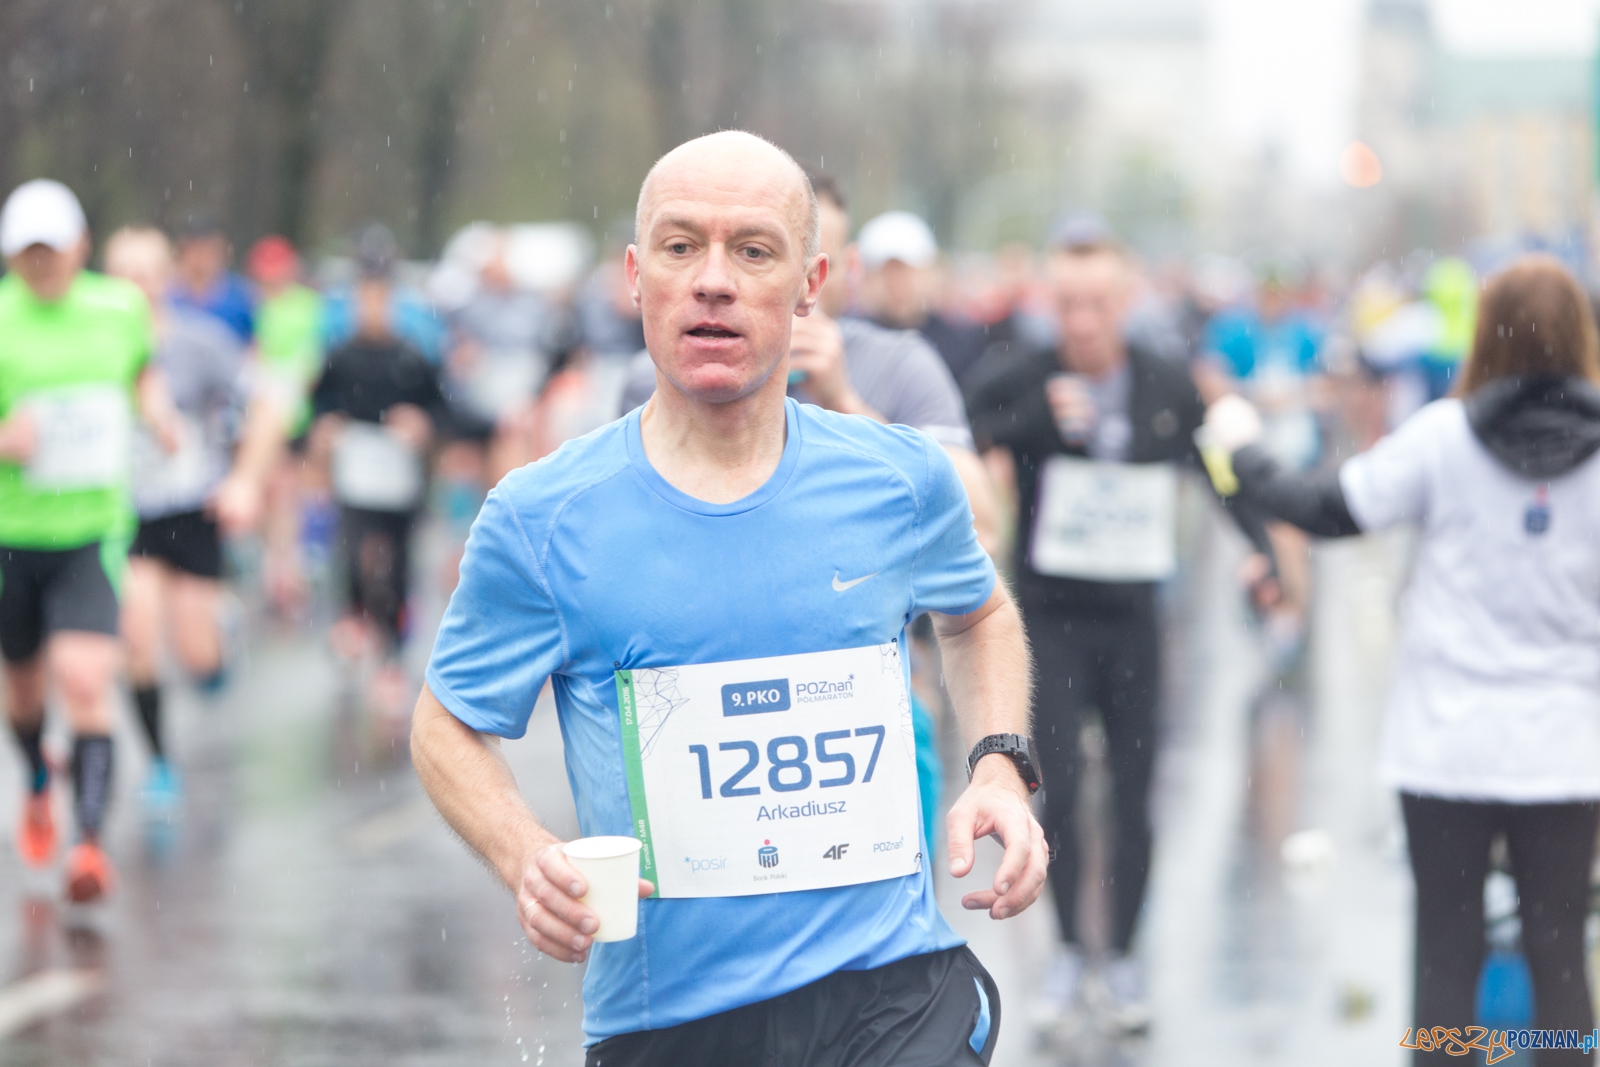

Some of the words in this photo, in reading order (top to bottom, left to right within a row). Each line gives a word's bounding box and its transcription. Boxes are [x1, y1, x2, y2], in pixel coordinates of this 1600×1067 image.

[622, 686, 633, 726] 17.04.2016
[797, 691, 854, 704] PÓŁMARATON
[688, 725, 886, 800] 12857
[756, 801, 847, 822] Arkadiusz
